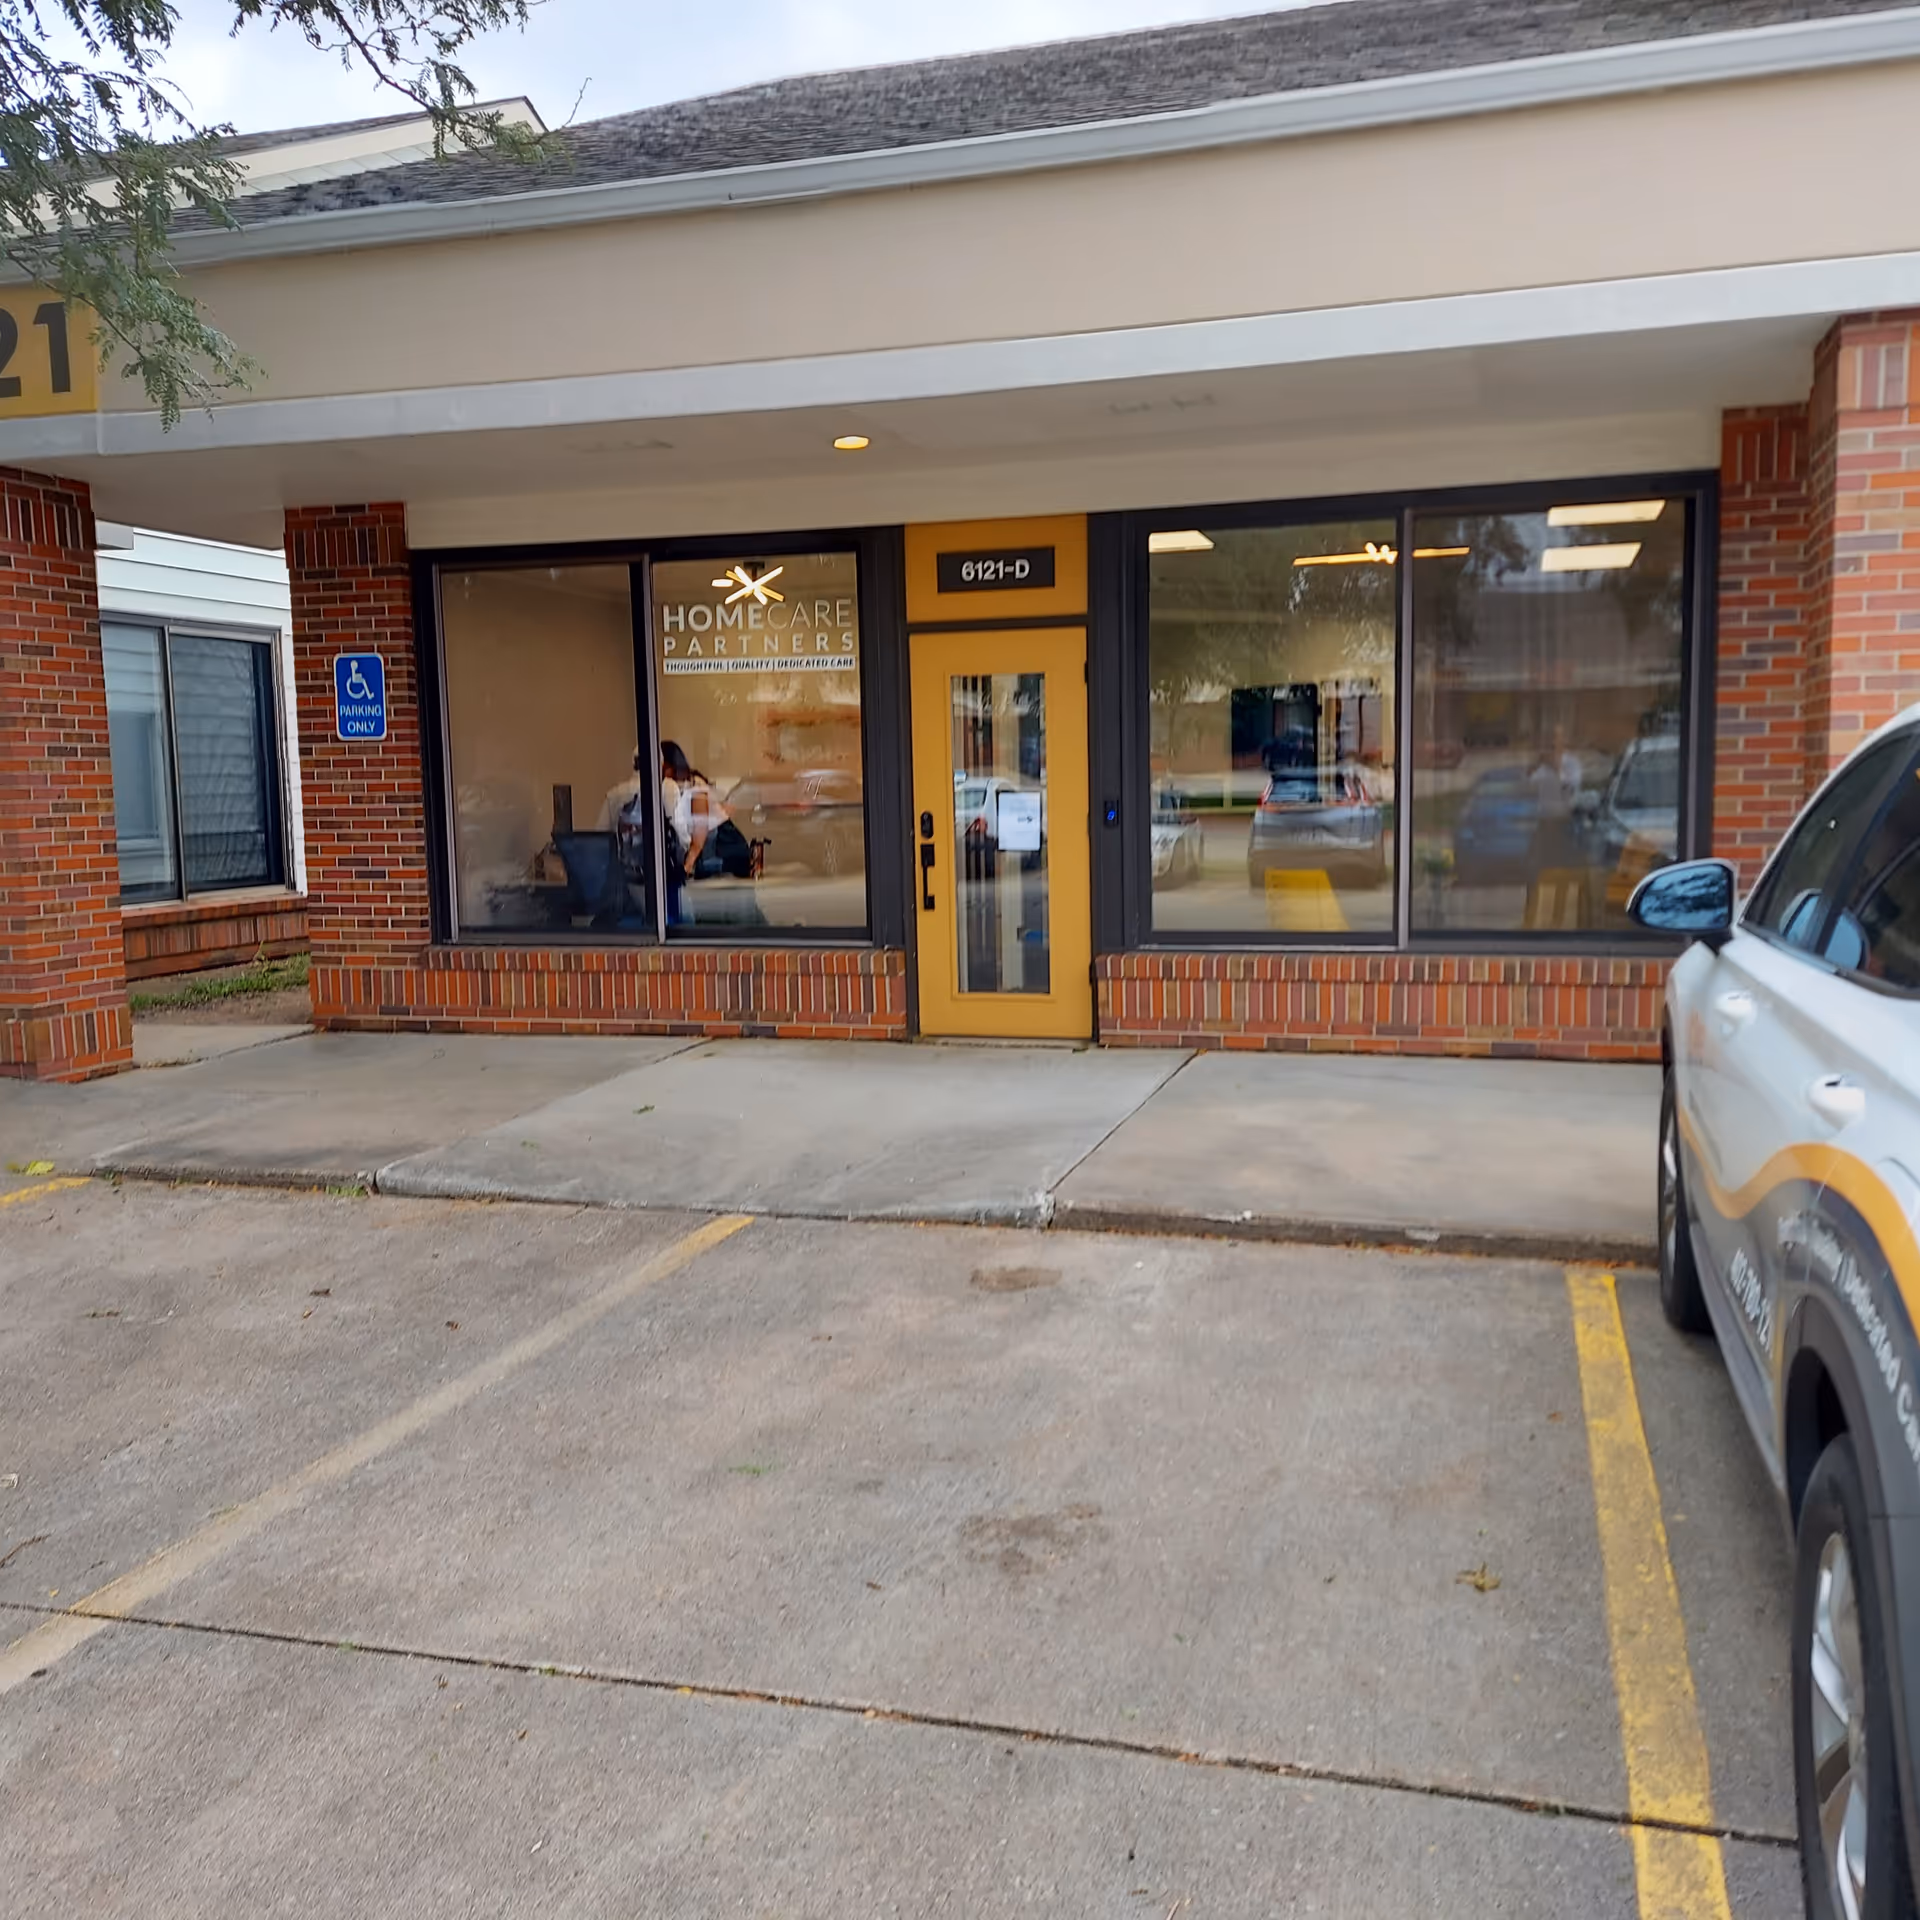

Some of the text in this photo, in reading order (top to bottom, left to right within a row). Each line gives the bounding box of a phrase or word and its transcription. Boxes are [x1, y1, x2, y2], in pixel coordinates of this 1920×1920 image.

[961, 558, 1030, 581] 6121-D
[662, 599, 851, 632] HOMECARE
[663, 631, 854, 657] PARTNERS
[665, 656, 854, 672] THOUGHTFUL QUALITY DEDICATED CARE
[340, 704, 382, 717] PARKING
[347, 720, 376, 733] ONLY
